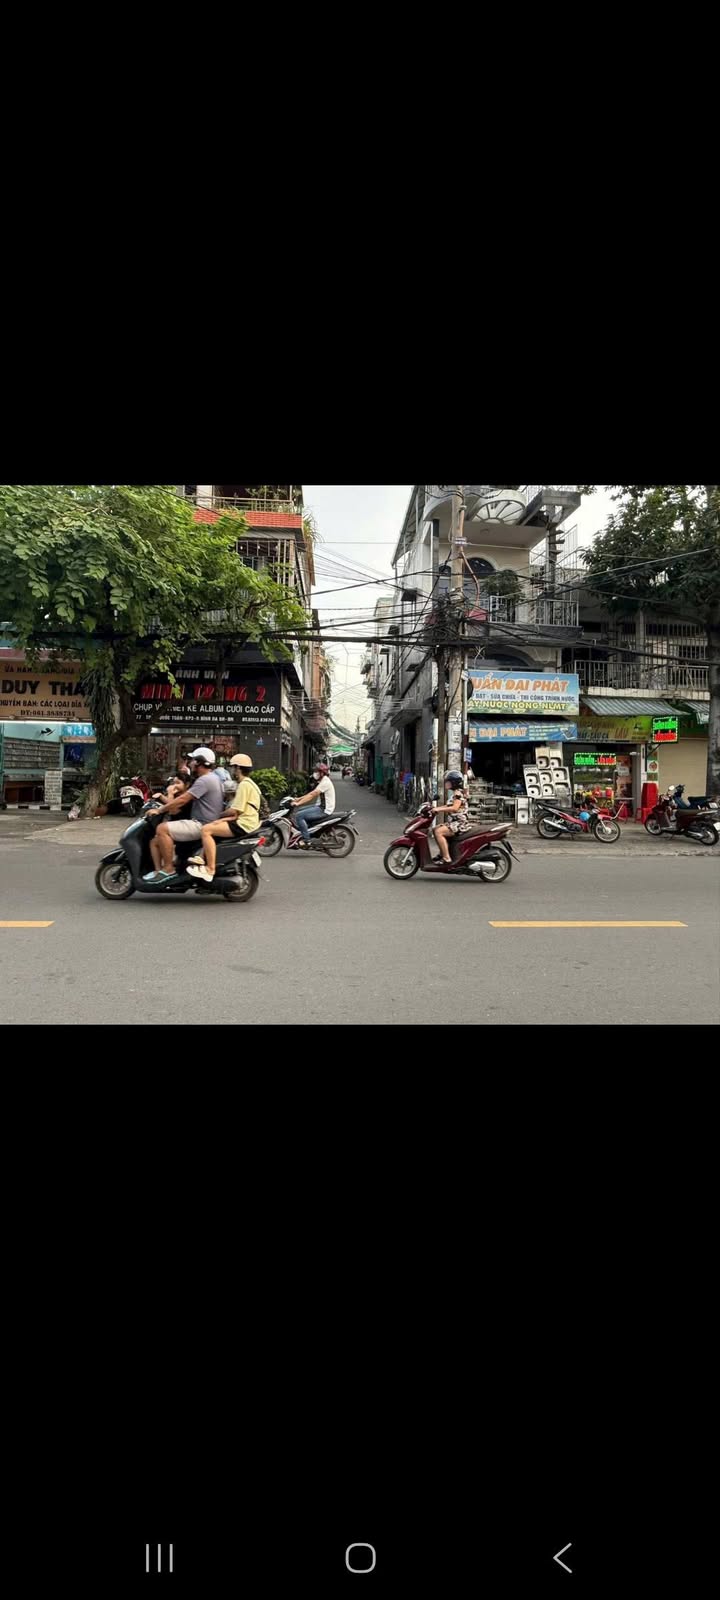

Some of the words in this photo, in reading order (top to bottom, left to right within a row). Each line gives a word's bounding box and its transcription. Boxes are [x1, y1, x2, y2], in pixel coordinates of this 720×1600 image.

[204, 670, 229, 679] VIN
[472, 672, 503, 690] UẤN
[532, 678, 568, 692] PHÁT
[1, 679, 40, 694] DUY
[194, 684, 248, 701] TRNG
[255, 685, 266, 702] 2
[133, 702, 153, 712] CHỤP
[200, 705, 224, 713] ALBUM
[245, 705, 259, 714] CAO
